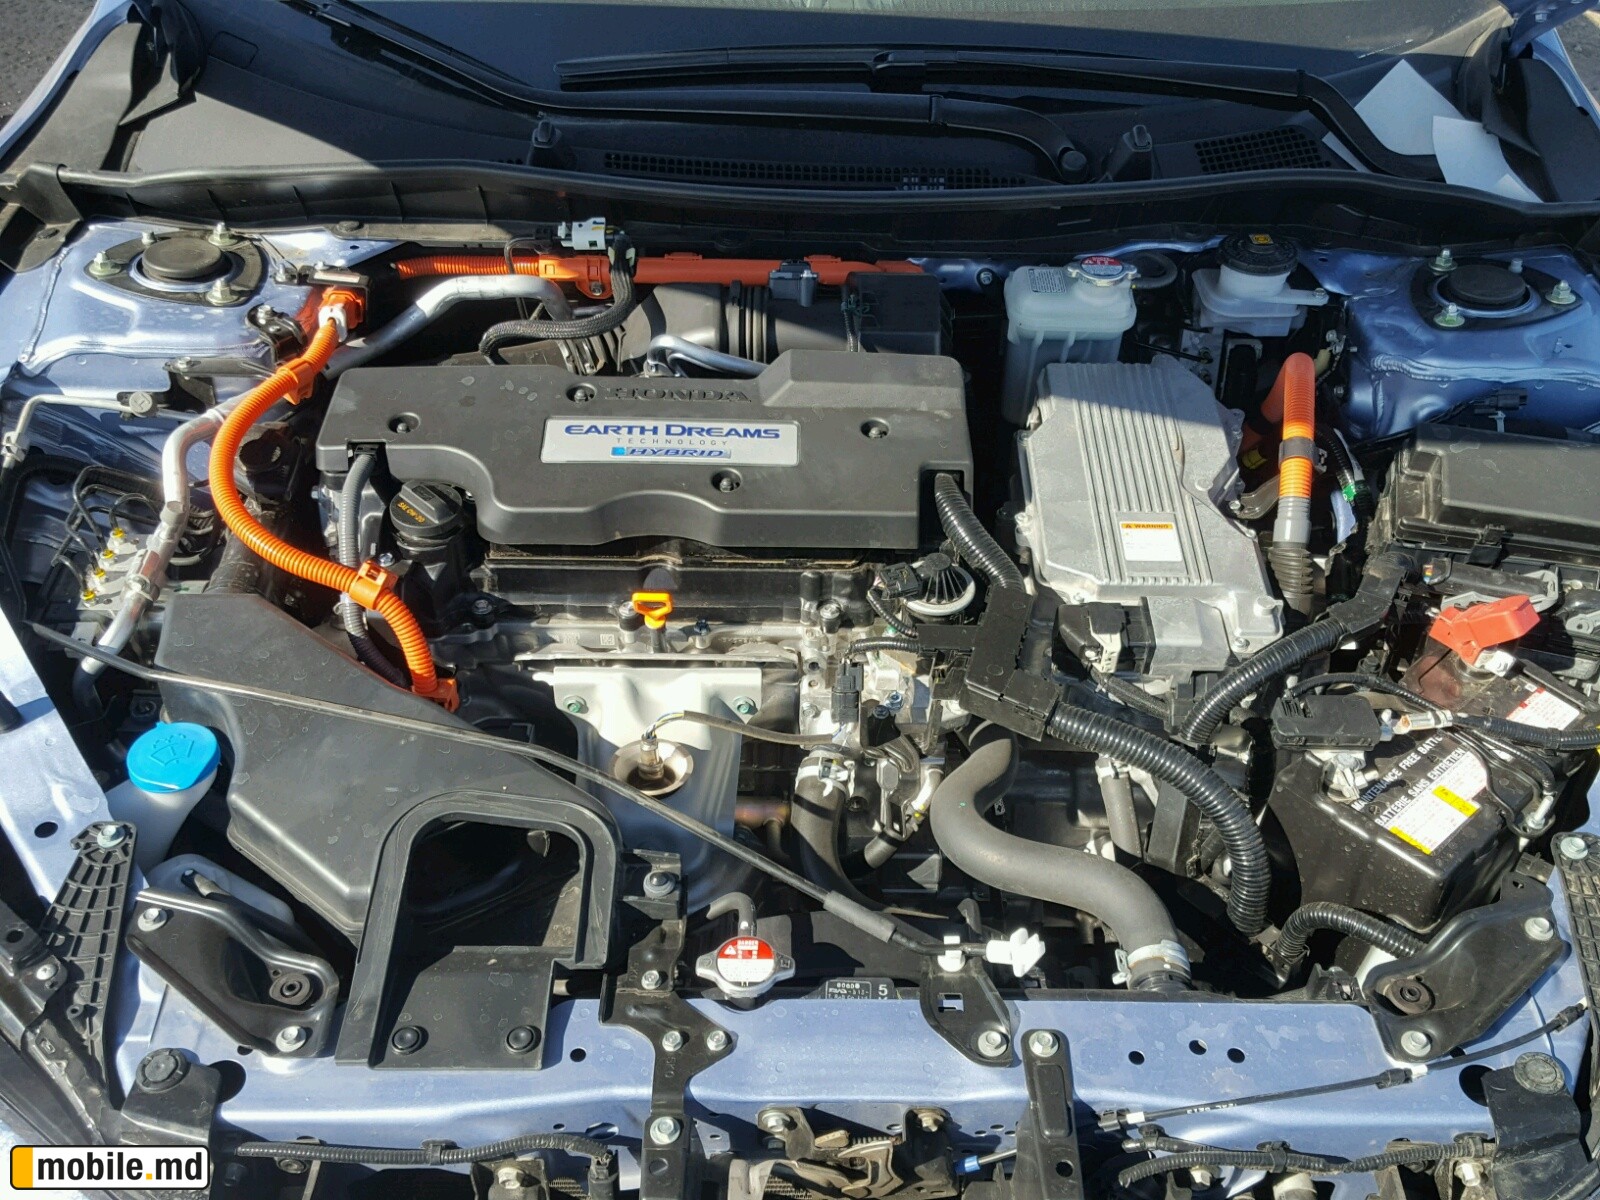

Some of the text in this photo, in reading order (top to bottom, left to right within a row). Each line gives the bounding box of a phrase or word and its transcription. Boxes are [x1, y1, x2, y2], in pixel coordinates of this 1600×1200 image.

[605, 388, 751, 402] HONDA
[565, 424, 780, 439] EARTH DREAMS
[616, 437, 728, 446] TECHNOLOGY
[629, 447, 724, 457] HYBRID
[1351, 768, 1402, 811] MAINTENANCE
[1399, 752, 1421, 771] FREE
[1374, 795, 1412, 825] BATTERIE
[1407, 778, 1430, 797] SANS
[1427, 747, 1466, 780] ENTRETIEN
